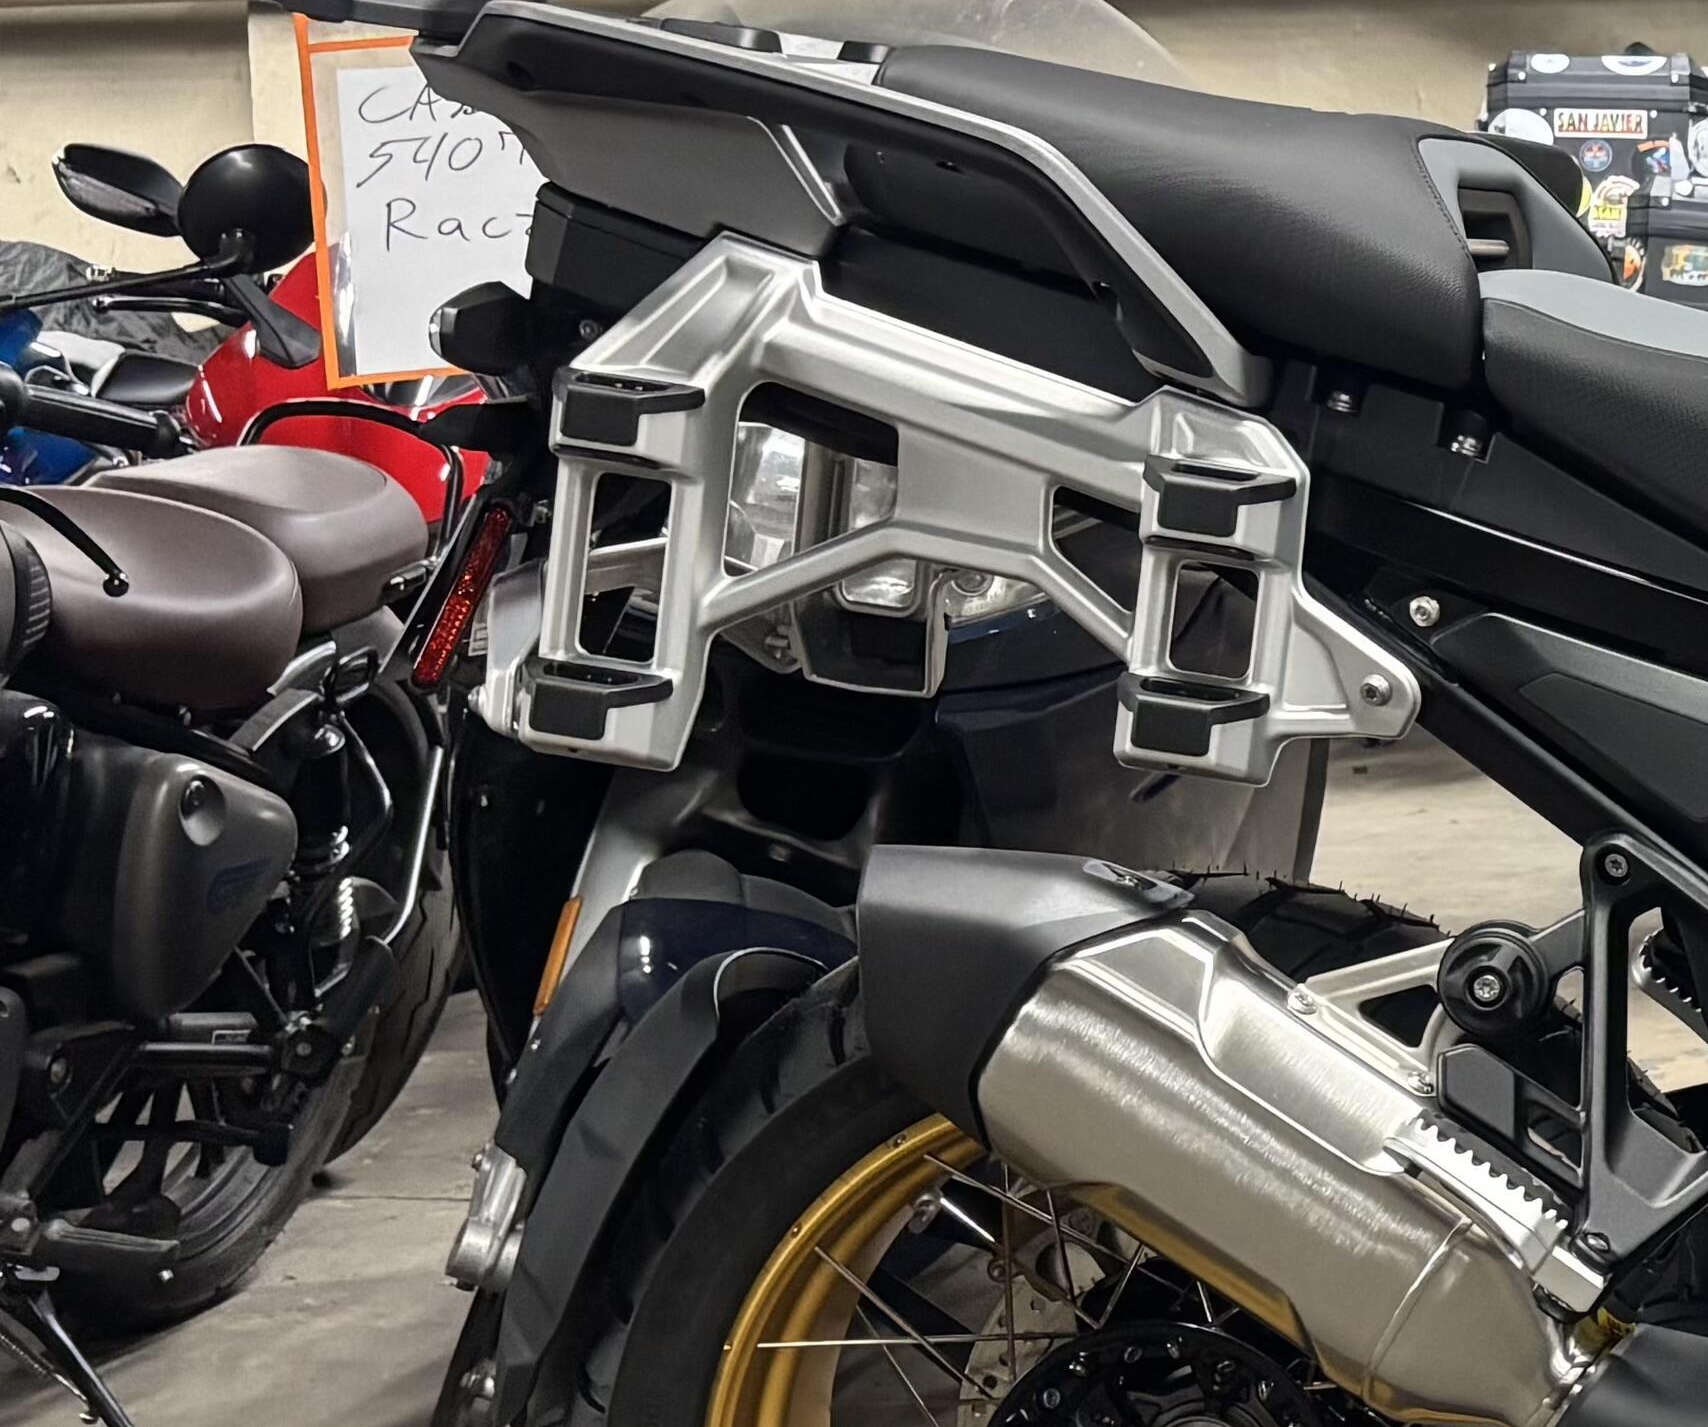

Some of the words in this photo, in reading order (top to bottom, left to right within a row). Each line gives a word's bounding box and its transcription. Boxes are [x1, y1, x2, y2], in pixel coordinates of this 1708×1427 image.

[1557, 112, 1588, 133] SAN
[1593, 113, 1643, 134] JAVIER
[386, 198, 533, 252] Rac
